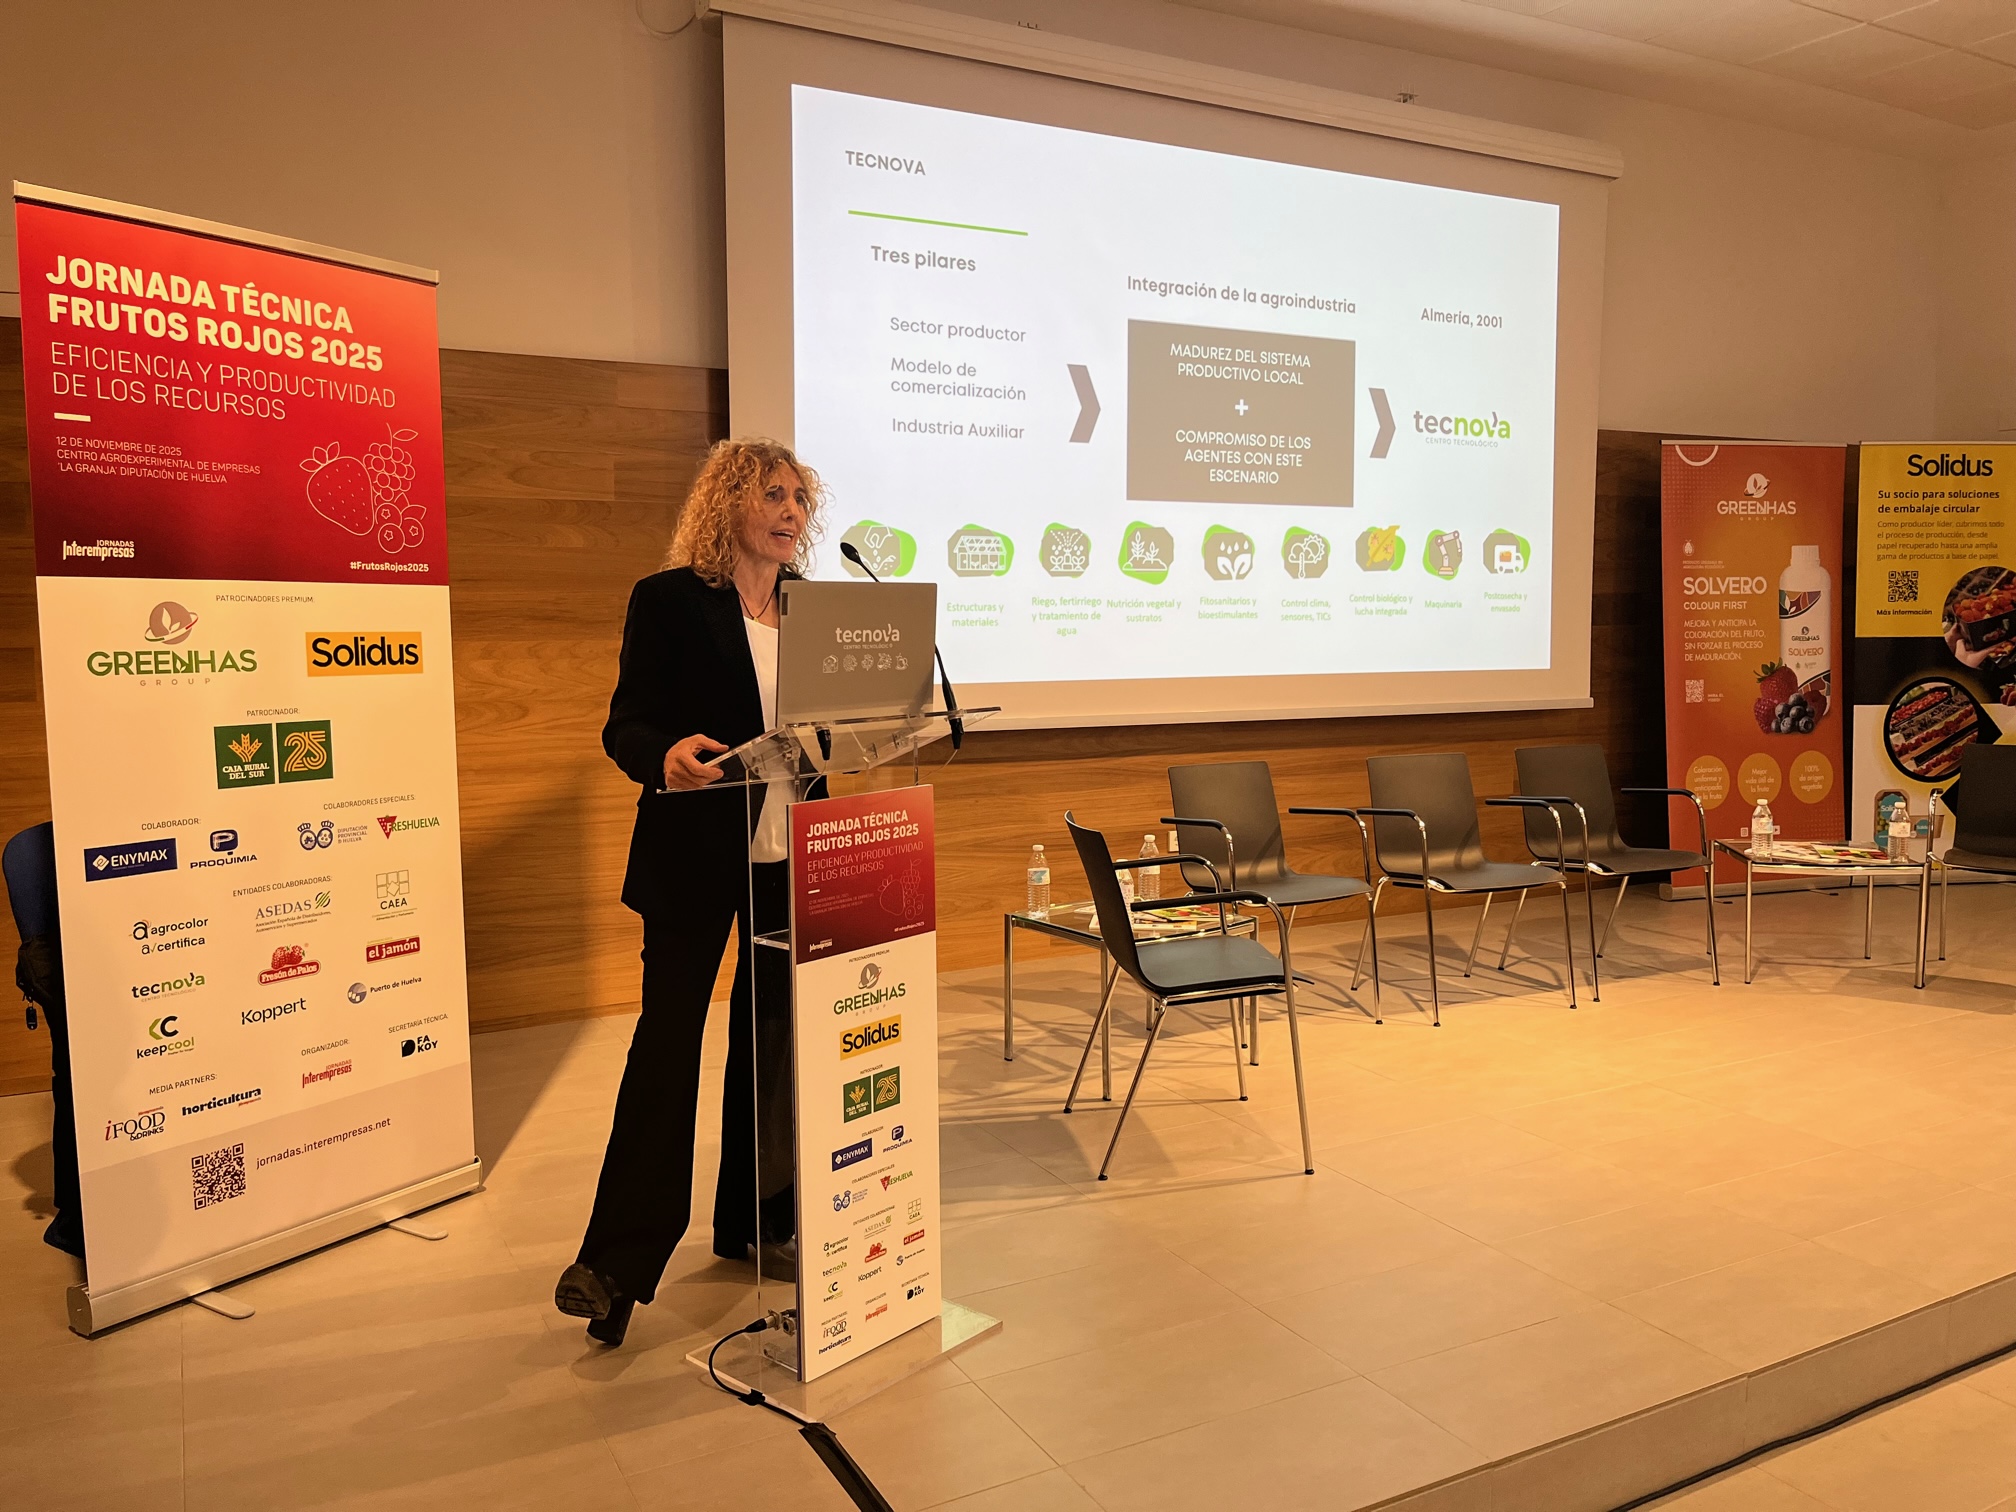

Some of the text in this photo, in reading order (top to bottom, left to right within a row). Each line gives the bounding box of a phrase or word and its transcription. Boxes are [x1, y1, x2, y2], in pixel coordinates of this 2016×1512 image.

[846, 150, 926, 176] TECNOVA
[871, 246, 976, 272] Tres pilares
[46, 255, 353, 334] JORNADA TÉCNICA
[1128, 275, 1356, 315] Integración de la agroindustria
[1421, 307, 1503, 329] Almería, 2001
[49, 293, 383, 372] FRUTOS ROJOS 2025
[890, 317, 1026, 342] Sector productor
[1170, 344, 1311, 368] MADUREZ DEL SISTEMA
[51, 342, 395, 408] EFICIENCIA Y PRODUCTIVIDAD
[891, 358, 977, 377] Modelo de
[1178, 363, 1304, 385] PRODUCTIVO LOCAL
[53, 372, 286, 420] DE LOS RECURSOS
[891, 380, 1026, 401] comercialización
[892, 418, 1025, 439] Industria Auxiliar
[1413, 410, 1511, 440] tecnova
[56, 437, 182, 456] 12 DE NOVIEMBRE DE 2025
[1175, 429, 1311, 450] COMPROMISO DE LOS
[1425, 437, 1499, 448] CENTRO TECNOLÓGICO
[57, 449, 260, 474] CENTRO AGROEXPERIMENTAL DE EMPRESAS
[1184, 449, 1303, 467] AGENTES CON ESTE
[1907, 454, 1993, 476] Solidus
[121, 467, 174, 480] DIPUTACIÓN
[177, 472, 189, 481] DE
[191, 473, 227, 483] HUELVA
[1210, 469, 1279, 484] ESCENARIO
[1878, 490, 1999, 500] Su socio para soluciones
[1717, 501, 1796, 515] GREENHAS
[1878, 504, 1980, 515] de embalaje circular
[63, 540, 135, 561] Interempresas
[97, 539, 134, 548] JORNADAS
[350, 561, 429, 573] #FrutosRojos2025
[1683, 576, 1767, 595] SOLVERO
[947, 602, 1004, 613] Estructuras y
[1107, 599, 1181, 609] Nutrición vegetal y
[1425, 601, 1462, 609] Maquinaria
[1684, 601, 1747, 610] COLOUR FIRST
[952, 617, 999, 627] materiales
[1032, 611, 1101, 622] y tratamiento de
[1126, 614, 1162, 623] sustratos
[1198, 610, 1258, 619] bioestimulantes
[1684, 620, 1710, 628] MEJORA
[1718, 619, 1748, 627] ANTICIPA
[1749, 619, 1756, 627] LA
[836, 624, 900, 642] tecnova
[1057, 627, 1077, 636] agua
[1684, 629, 1766, 640] COLORACIÓN DEL FRUTO,
[312, 636, 419, 668] Solidus
[1685, 641, 1763, 650] SIN FORZAR EL PROCESO
[87, 649, 258, 677] GREENHAS
[1685, 651, 1742, 662] DE MADURACIÓN.
[140, 677, 212, 687] GROUP
[284, 730, 328, 772] 25
[222, 762, 269, 774] CAJA RURAL
[249, 770, 265, 778] SUR
[806, 810, 908, 838] JORNADA TÉCNICA
[807, 823, 919, 854] FRUTOS ROJOS 2025
[111, 849, 167, 867] ENYMAX
[190, 854, 257, 869] PROQUIMIA
[808, 841, 923, 871] EFICIENCIA Y PRODUCTIVIDAD
[808, 860, 884, 883] DE LOS RECURSOS
[233, 875, 332, 897] ENTIDADES COLABORADORAS:
[255, 899, 312, 919] ASEDAS
[380, 897, 407, 910] CAEA
[151, 918, 208, 936] agrocolor
[368, 948, 379, 958] el
[382, 939, 418, 957] jamón
[261, 964, 318, 982] Fresón de Palos
[132, 972, 205, 998] tecnova
[370, 984, 390, 993] Puerto
[401, 977, 421, 986] Huelva
[834, 983, 906, 1015] GREENHAS
[241, 997, 306, 1025] Koppert
[417, 1035, 430, 1044] FA
[417, 1040, 438, 1053] KOY
[842, 1023, 899, 1053] Solidus
[137, 1037, 194, 1059] keepcool
[326, 1059, 352, 1071] JORNADAS
[149, 1074, 217, 1095] MEDIA PARTNERS:
[302, 1064, 352, 1088] Interempresas
[876, 1074, 897, 1104] 25
[182, 1088, 261, 1116] horticultura
[105, 1111, 165, 1141] iFOOD
[130, 1126, 164, 1141] &DRINKS
[256, 1117, 391, 1169] jornadas.interempresas.net
[842, 1145, 868, 1160] ENYMAX
[858, 1266, 882, 1282] Koppert
